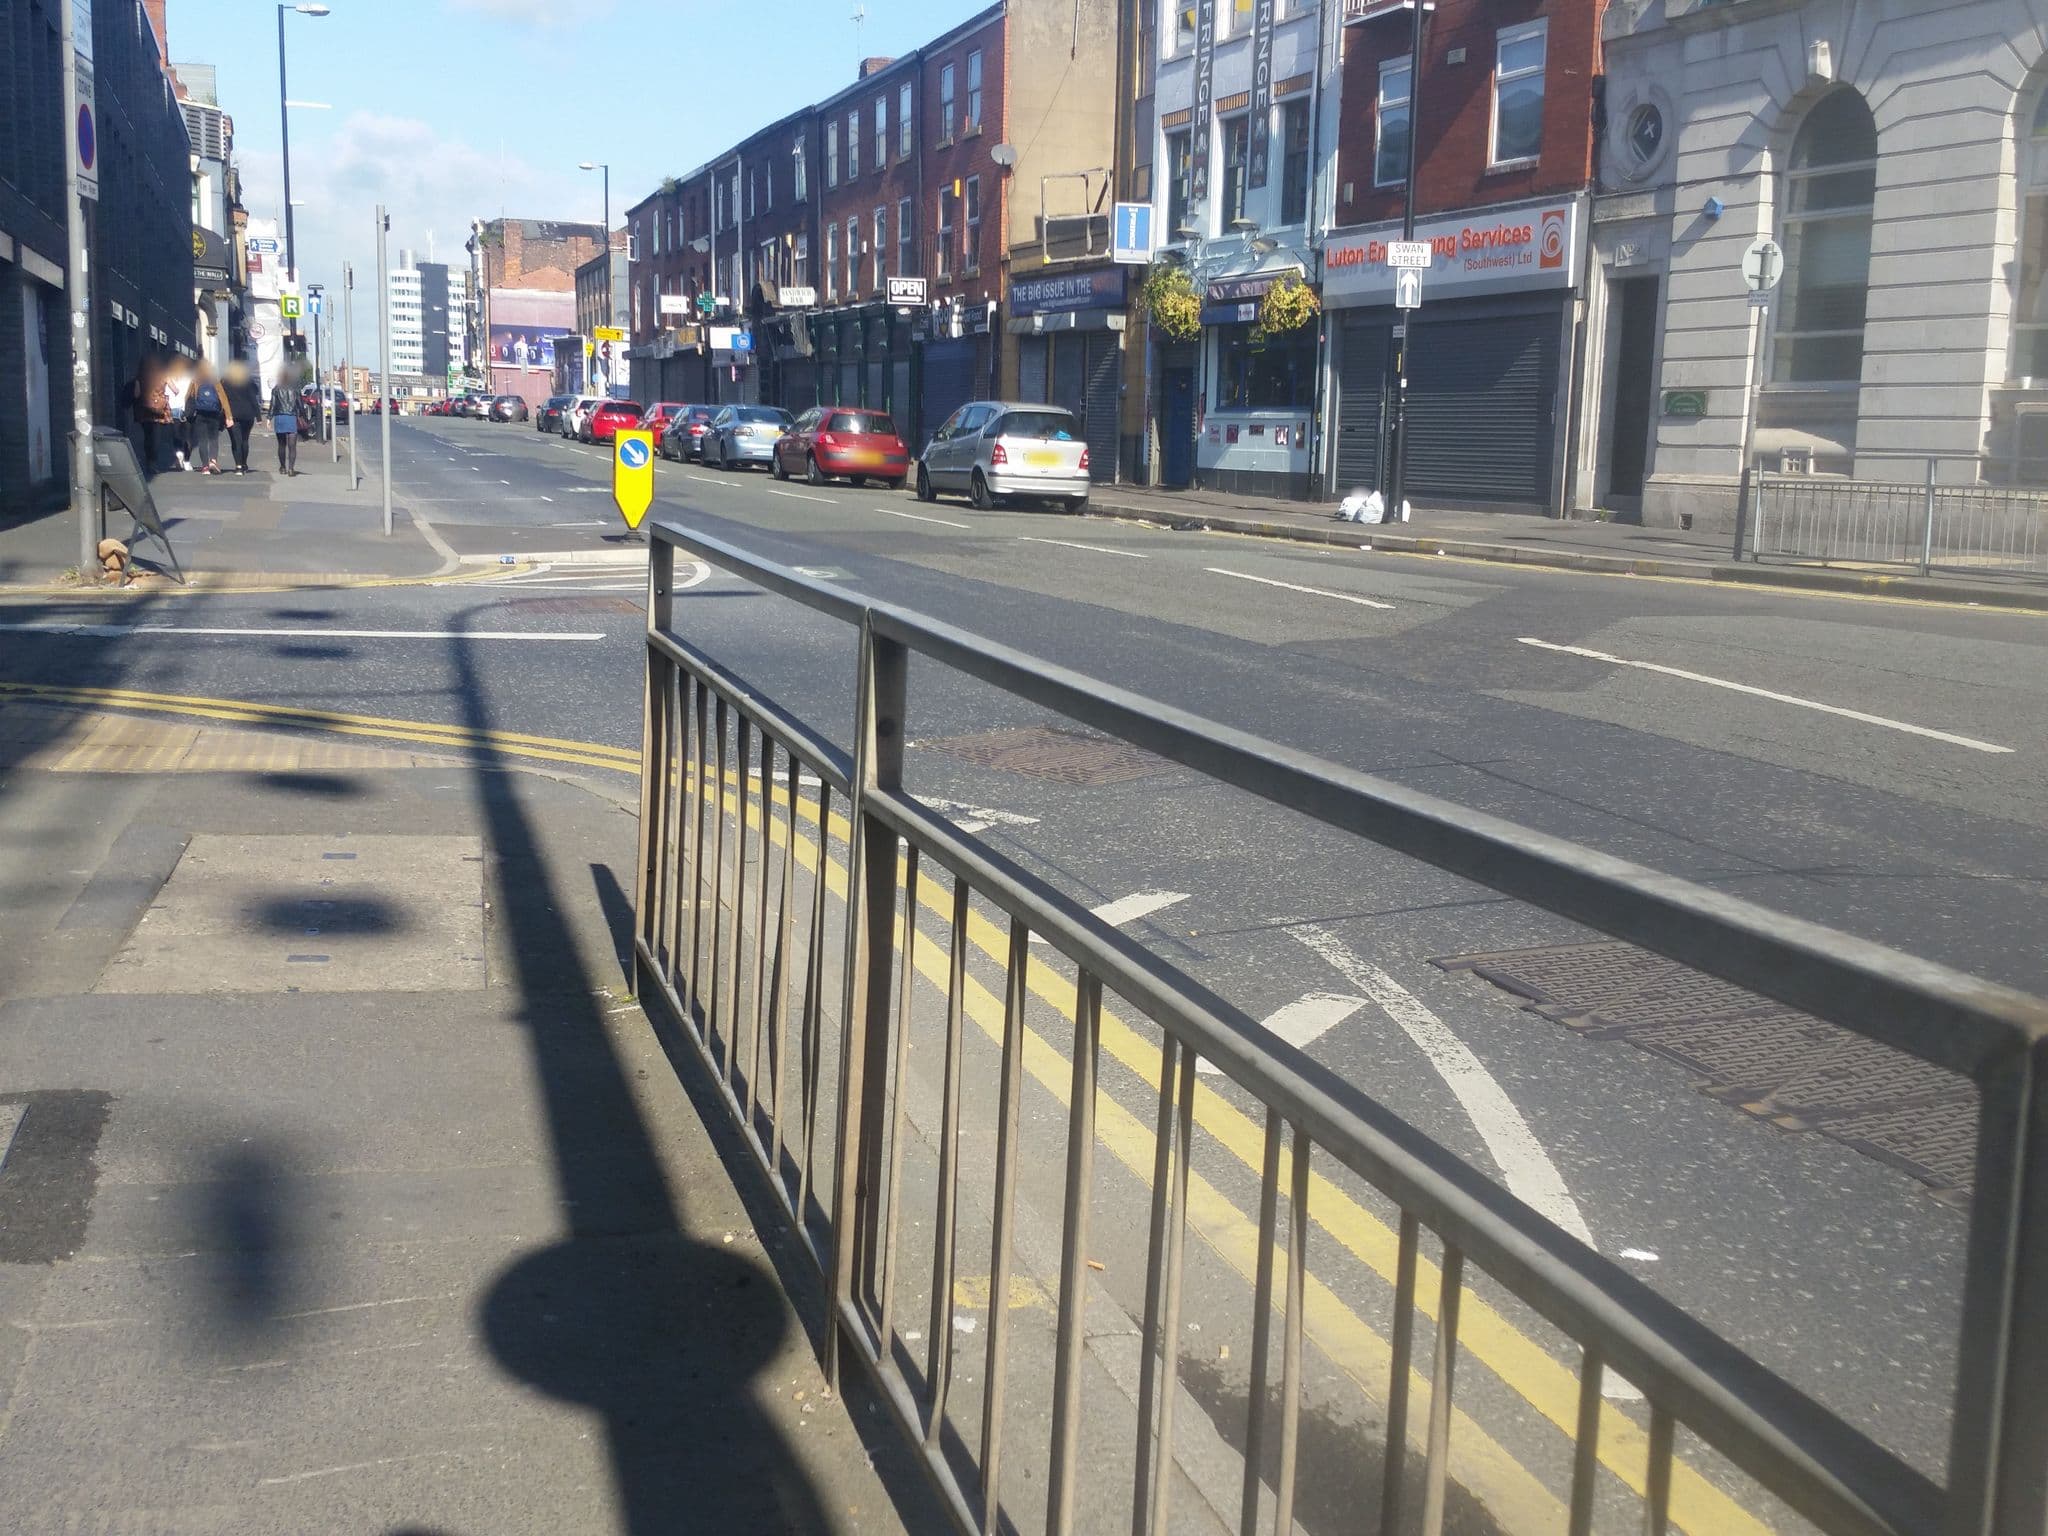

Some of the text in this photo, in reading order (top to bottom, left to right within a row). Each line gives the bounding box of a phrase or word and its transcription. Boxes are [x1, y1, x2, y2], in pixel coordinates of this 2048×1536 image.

[1198, 1, 1212, 125] FRINGE
[1327, 246, 1364, 269] Luton
[1461, 224, 1533, 252] Services
[1395, 243, 1424, 254] SWAN
[1391, 255, 1428, 266] STREET
[1464, 251, 1532, 272] (Southwest) Ltd
[890, 280, 923, 296] OPEN
[1012, 285, 1027, 303] THE
[1027, 283, 1041, 301] BIG
[1042, 281, 1065, 299] ISSUE
[1066, 279, 1075, 296] IN
[1076, 277, 1092, 295] THE
[286, 302, 298, 313] R
